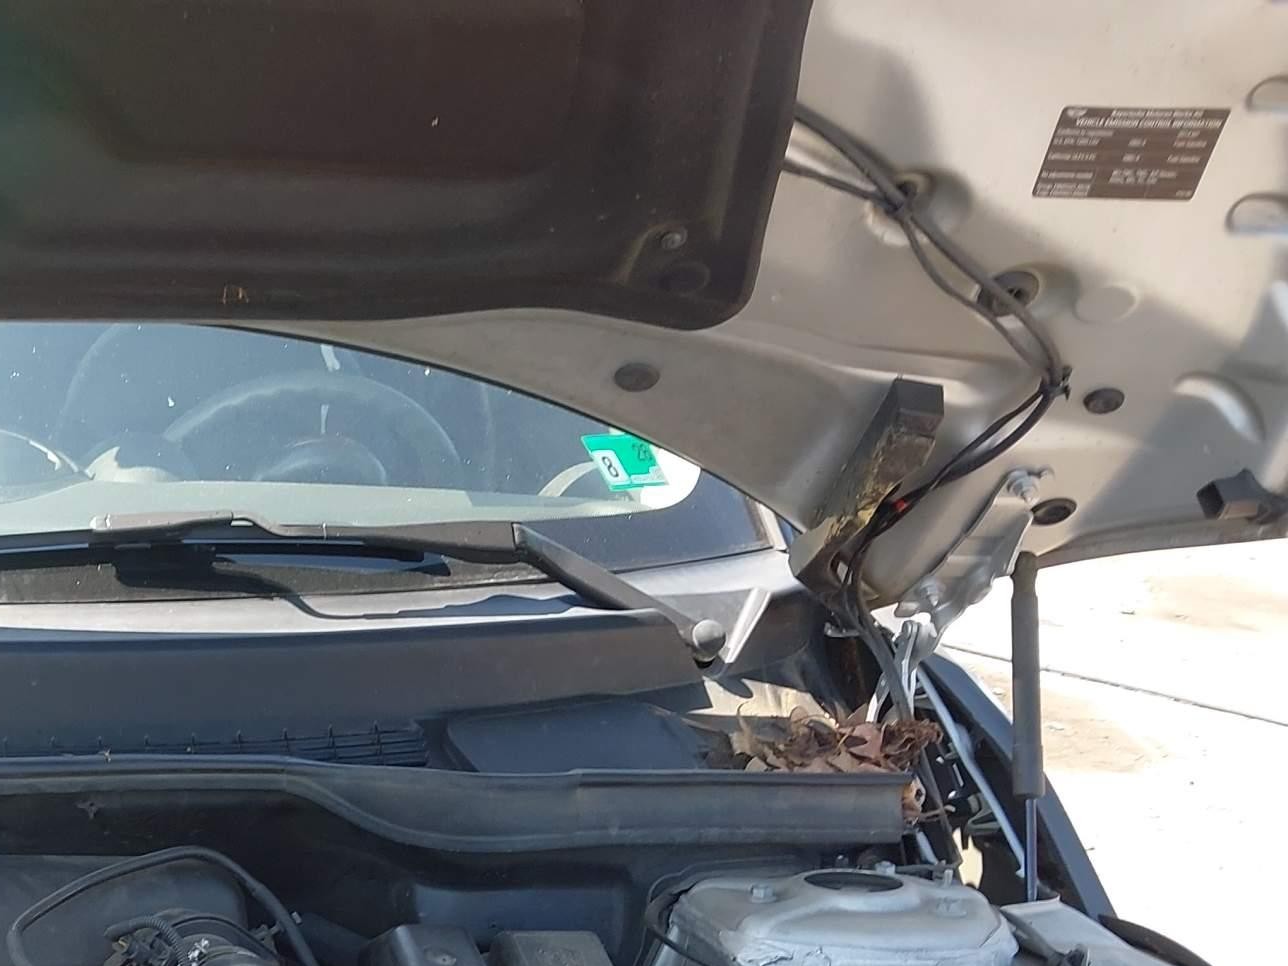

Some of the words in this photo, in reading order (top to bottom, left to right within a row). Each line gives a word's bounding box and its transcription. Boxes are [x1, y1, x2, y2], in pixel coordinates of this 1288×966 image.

[1076, 118, 1105, 127] VEHICLE
[1105, 118, 1139, 128] EMISSION
[1139, 119, 1171, 128] CONTROL
[1172, 119, 1223, 128] INFORMATION
[601, 456, 619, 478] 8
